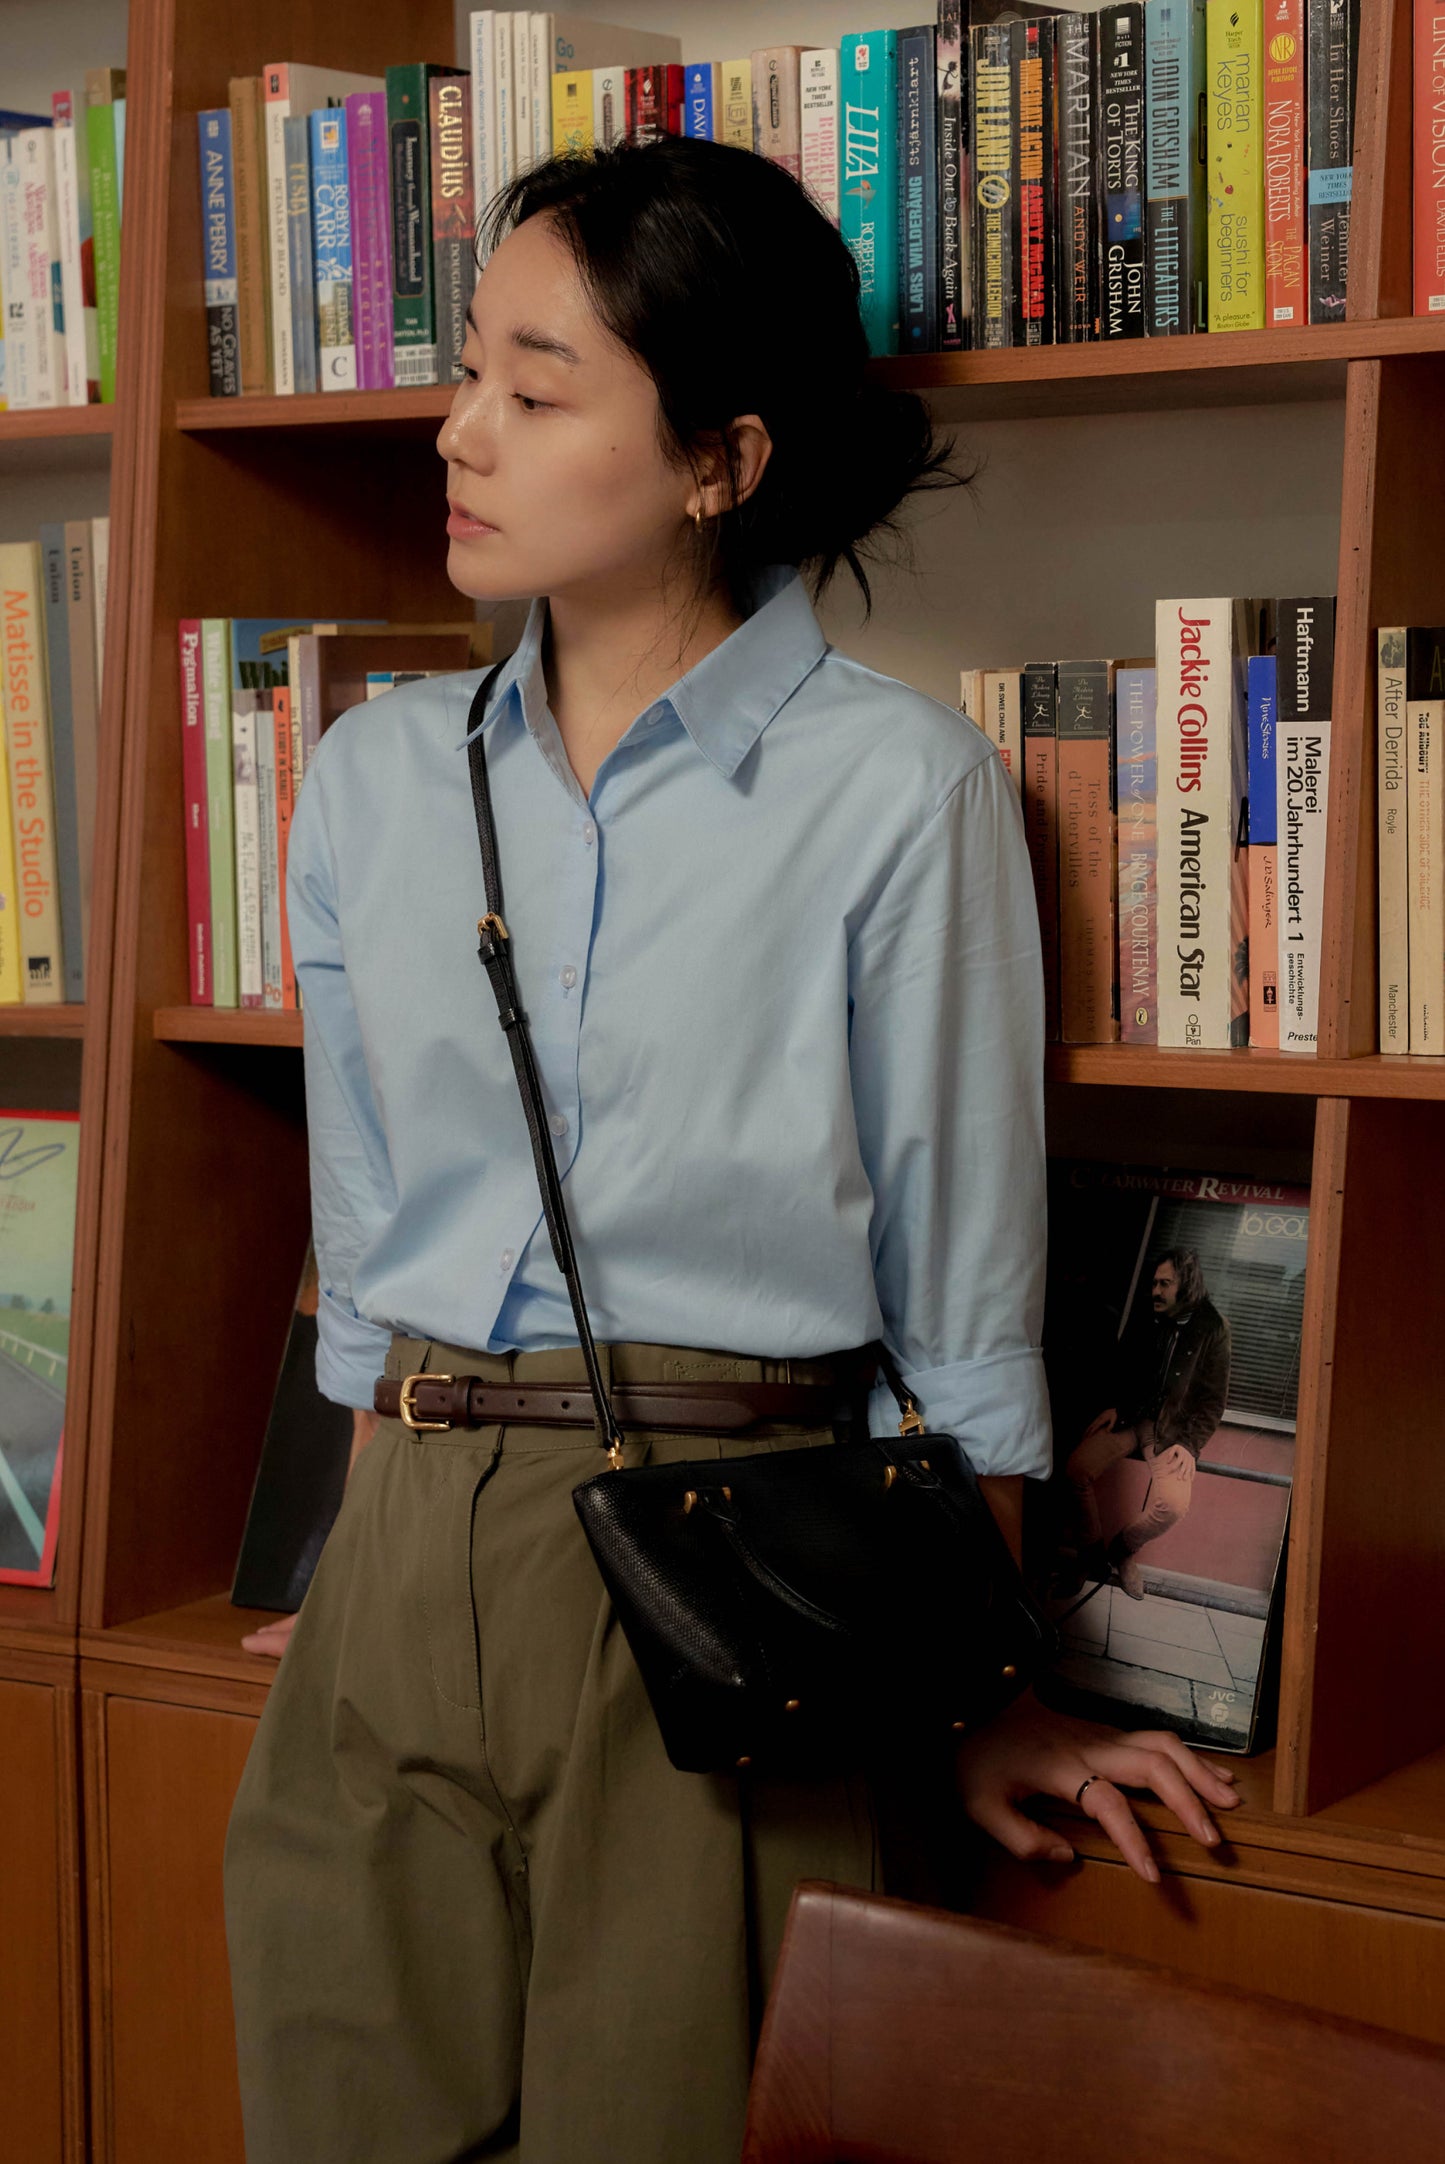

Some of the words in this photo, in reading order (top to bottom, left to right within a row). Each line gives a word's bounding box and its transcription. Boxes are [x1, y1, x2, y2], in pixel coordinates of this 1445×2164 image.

[555, 36, 574, 59] Go
[1067, 23, 1089, 33] THE
[1274, 34, 1293, 60] NR
[1432, 16, 1445, 72] LINE
[1113, 52, 1130, 68] #1
[1122, 69, 1138, 77] YORK
[1329, 42, 1345, 63] In
[976, 58, 1011, 108] JON
[1019, 57, 1043, 129] IMMEDIATE
[1105, 85, 1141, 95] BESTSELLER
[1114, 78, 1132, 86] TIMES
[1152, 58, 1180, 103] JOHN
[1212, 59, 1238, 131] keyes
[1235, 53, 1254, 133] marian
[1329, 68, 1344, 103] Her
[1432, 75, 1445, 98] OF
[692, 98, 707, 141] DAVI
[804, 101, 834, 109] BESTSELLER
[907, 57, 922, 166] Stjärnklart
[1066, 37, 1091, 198] MARTIAN
[1107, 103, 1122, 138] OF
[1124, 99, 1141, 136] THE
[1267, 100, 1293, 152] NORA
[438, 85, 470, 199] CLAUDIUS
[479, 132, 488, 161] Guide
[819, 116, 836, 187] ROBERT
[845, 101, 880, 181] LILA
[944, 116, 957, 150] Inside
[976, 112, 1011, 172] LAND
[1151, 106, 1181, 191] GRISHAM
[1293, 144, 1301, 162] Times
[1329, 105, 1345, 160] Shoes
[1431, 99, 1445, 190] VISION
[403, 137, 419, 181] Journey
[944, 152, 958, 191] Out
[1019, 131, 1043, 181] ACTION
[1106, 139, 1124, 190] TORTS
[1125, 138, 1141, 188] KING
[1320, 174, 1334, 182] NEW
[205, 150, 227, 209] ANNE
[237, 167, 248, 192] AND
[1266, 152, 1294, 223] ROBERTS
[1292, 163, 1301, 195] Bestselling
[1327, 182, 1347, 190] TIMES
[239, 194, 249, 229] HOME
[273, 177, 286, 228] PETALS
[315, 183, 338, 249] CARR
[334, 183, 350, 248] ROBYN
[906, 176, 924, 268] WILDERÄNG
[986, 212, 1002, 231] THE
[1029, 184, 1044, 240] ANDY
[1160, 206, 1174, 224] THE
[1293, 196, 1301, 217] Author
[208, 213, 229, 274] PERRY
[276, 228, 286, 246] OF
[407, 208, 422, 283] Womanhood
[860, 221, 875, 275] ROBERT
[945, 216, 958, 252] Back
[1074, 205, 1086, 252] ANDY
[1235, 215, 1251, 266] sushi
[1286, 227, 1298, 241] THE
[1319, 217, 1337, 282] Weiner
[1337, 212, 1351, 285] Jennifer
[276, 249, 288, 297] BLOOD
[450, 242, 463, 300] DOUGLAS
[941, 256, 958, 300] Again
[986, 233, 1003, 281] OMICRON
[1154, 226, 1180, 328] LITIGATORS
[1216, 213, 1237, 303] beginners
[1266, 239, 1285, 280] STONE
[1283, 245, 1302, 289] PAGAN
[909, 271, 924, 314] LARS
[986, 282, 1003, 319] LEGION
[1074, 259, 1087, 304] WEIR
[1107, 244, 1125, 335] GRISHAM
[1123, 262, 1143, 314] JOHN
[1235, 271, 1251, 297] for
[221, 306, 235, 332] NO
[325, 306, 338, 345] BEND
[360, 261, 373, 351] JACQUES
[209, 325, 222, 347] AS
[452, 302, 464, 357] JACKSON
[211, 349, 224, 377] YET
[222, 333, 238, 394] GRAVES
[331, 356, 348, 378] C
[48, 549, 63, 604] Union
[70, 546, 84, 602] Union
[3, 588, 34, 713] Matisse
[205, 631, 224, 688] White
[1178, 606, 1212, 697] Jackie
[1296, 606, 1315, 712] Haftmann
[184, 632, 200, 726] Pygmalion
[999, 682, 1006, 693] DR
[1129, 680, 1144, 716] THE
[1384, 676, 1404, 721] After
[208, 692, 225, 740] Fang
[998, 693, 1006, 712] SWEE
[1260, 694, 1273, 722] Nine
[12, 720, 39, 749] in
[278, 731, 287, 755] STUDY
[290, 721, 303, 776] Classical
[998, 729, 1006, 744] ANG
[1130, 719, 1145, 786] POWER
[1176, 703, 1209, 794] Collins
[1259, 721, 1273, 761] Stories
[1286, 736, 1303, 763] im
[279, 758, 287, 767] IN
[1036, 752, 1050, 793] Pride
[1286, 765, 1304, 797] 20.
[1304, 736, 1322, 814] Malerei
[1384, 726, 1403, 791] Derrida
[14, 757, 44, 809] the
[1088, 780, 1102, 819] Tess
[1419, 779, 1430, 799] THE
[1036, 799, 1049, 827] and
[1068, 770, 1083, 888] d'Urbervilles
[1088, 826, 1103, 844] of
[1131, 802, 1146, 842] ONE
[1386, 808, 1398, 836] Royle
[1419, 800, 1430, 832] OTHER
[1088, 850, 1102, 878] the
[1285, 798, 1305, 924] Jahrhundert
[1419, 833, 1430, 856] SIDE
[1419, 857, 1430, 868] OF
[18, 817, 51, 919] Studio
[1034, 833, 1050, 904] Prejudice
[1130, 852, 1149, 899] BRYCE
[1179, 807, 1210, 940] American
[1262, 878, 1275, 930] Salinger
[1419, 871, 1430, 911] SILENCE
[1086, 918, 1095, 976] THOMAS
[1131, 903, 1151, 997] COURTENAY
[1287, 932, 1304, 942] 1
[1176, 944, 1206, 1002] Star
[1287, 952, 1297, 1005] geschichte
[1294, 952, 1305, 1021] Entwicklungs-
[1086, 984, 1097, 1033] HARDY
[1387, 984, 1399, 1040] Manchester
[1185, 1037, 1202, 1046] Pan
[1193, 1176, 1285, 1202] REVIVAL
[1238, 1209, 1264, 1237] 16
[1208, 1690, 1236, 1704] JVC
